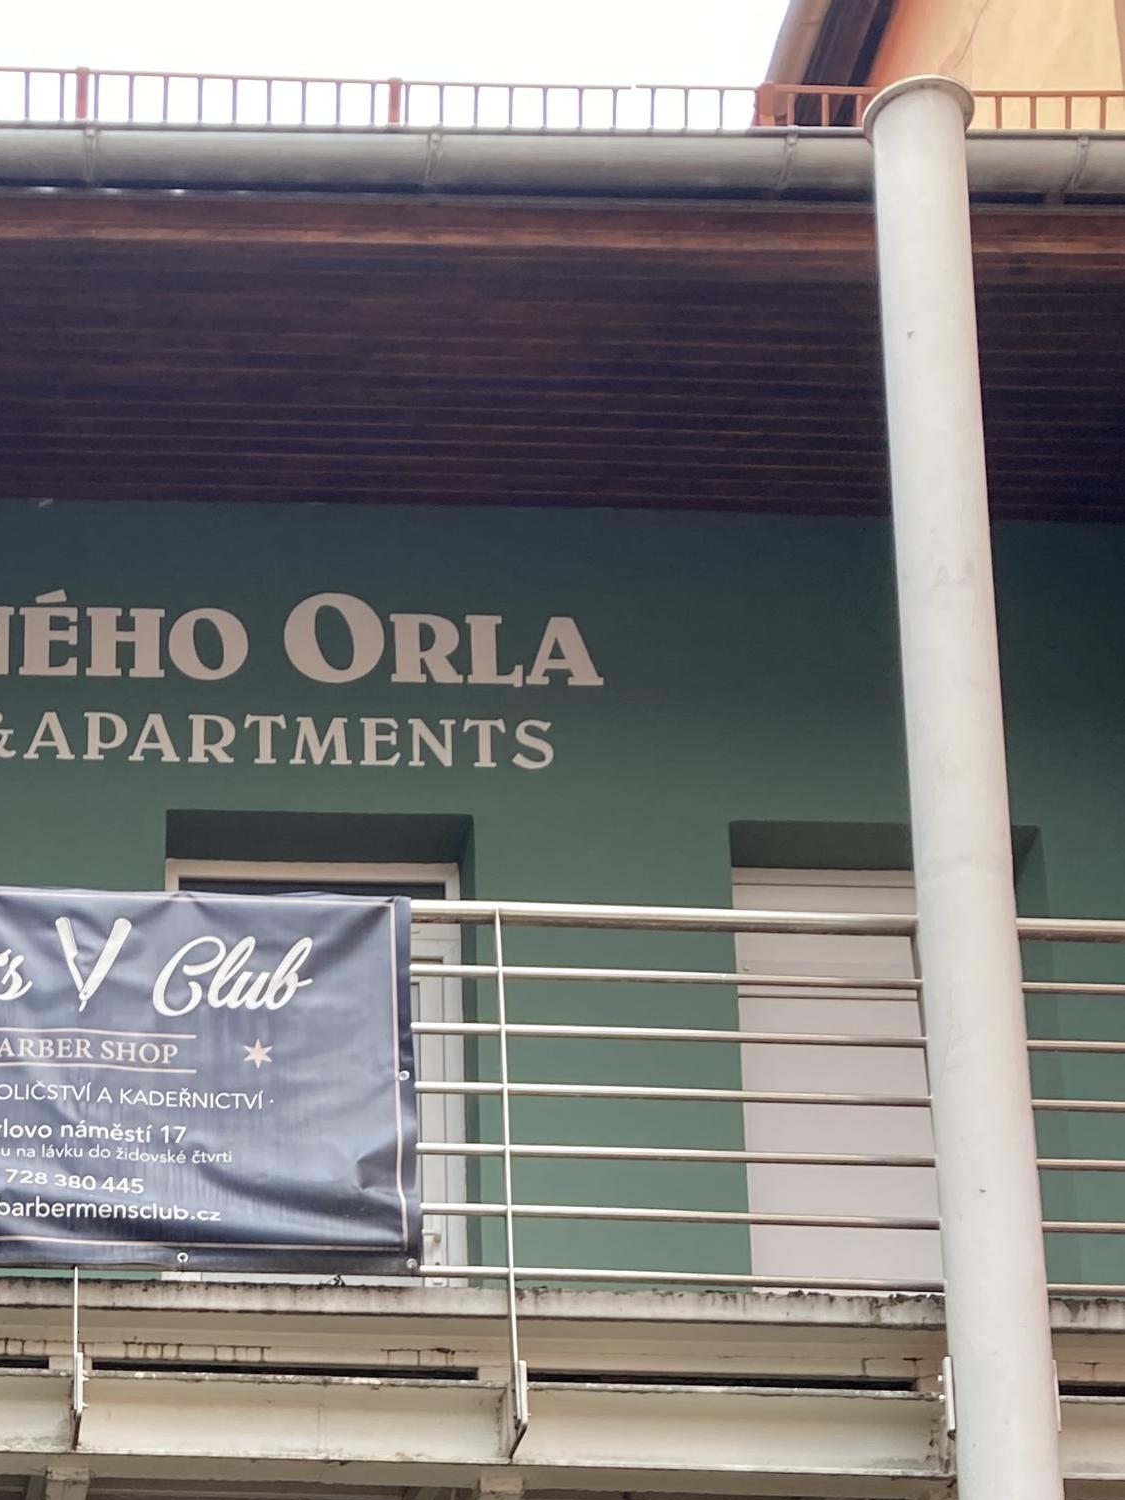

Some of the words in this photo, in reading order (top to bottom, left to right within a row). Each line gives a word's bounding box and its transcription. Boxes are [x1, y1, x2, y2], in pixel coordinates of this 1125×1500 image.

[283, 592, 604, 688] ORLA
[22, 710, 555, 770] APARTMENTS
[152, 935, 314, 1017] Club
[99, 1040, 179, 1065] SHOP
[97, 1086, 113, 1104] A
[119, 1087, 265, 1110] KADEŘNICTVÍ
[60, 1119, 152, 1144] náměstí
[160, 1125, 187, 1145] 17
[15, 1145, 36, 1158] na
[40, 1143, 83, 1159] lávku
[88, 1144, 111, 1159] do
[115, 1146, 187, 1164] židovské
[191, 1149, 233, 1164] čtvrti
[4, 1168, 49, 1185] 728
[53, 1172, 97, 1191] 380
[101, 1176, 145, 1194] 445
